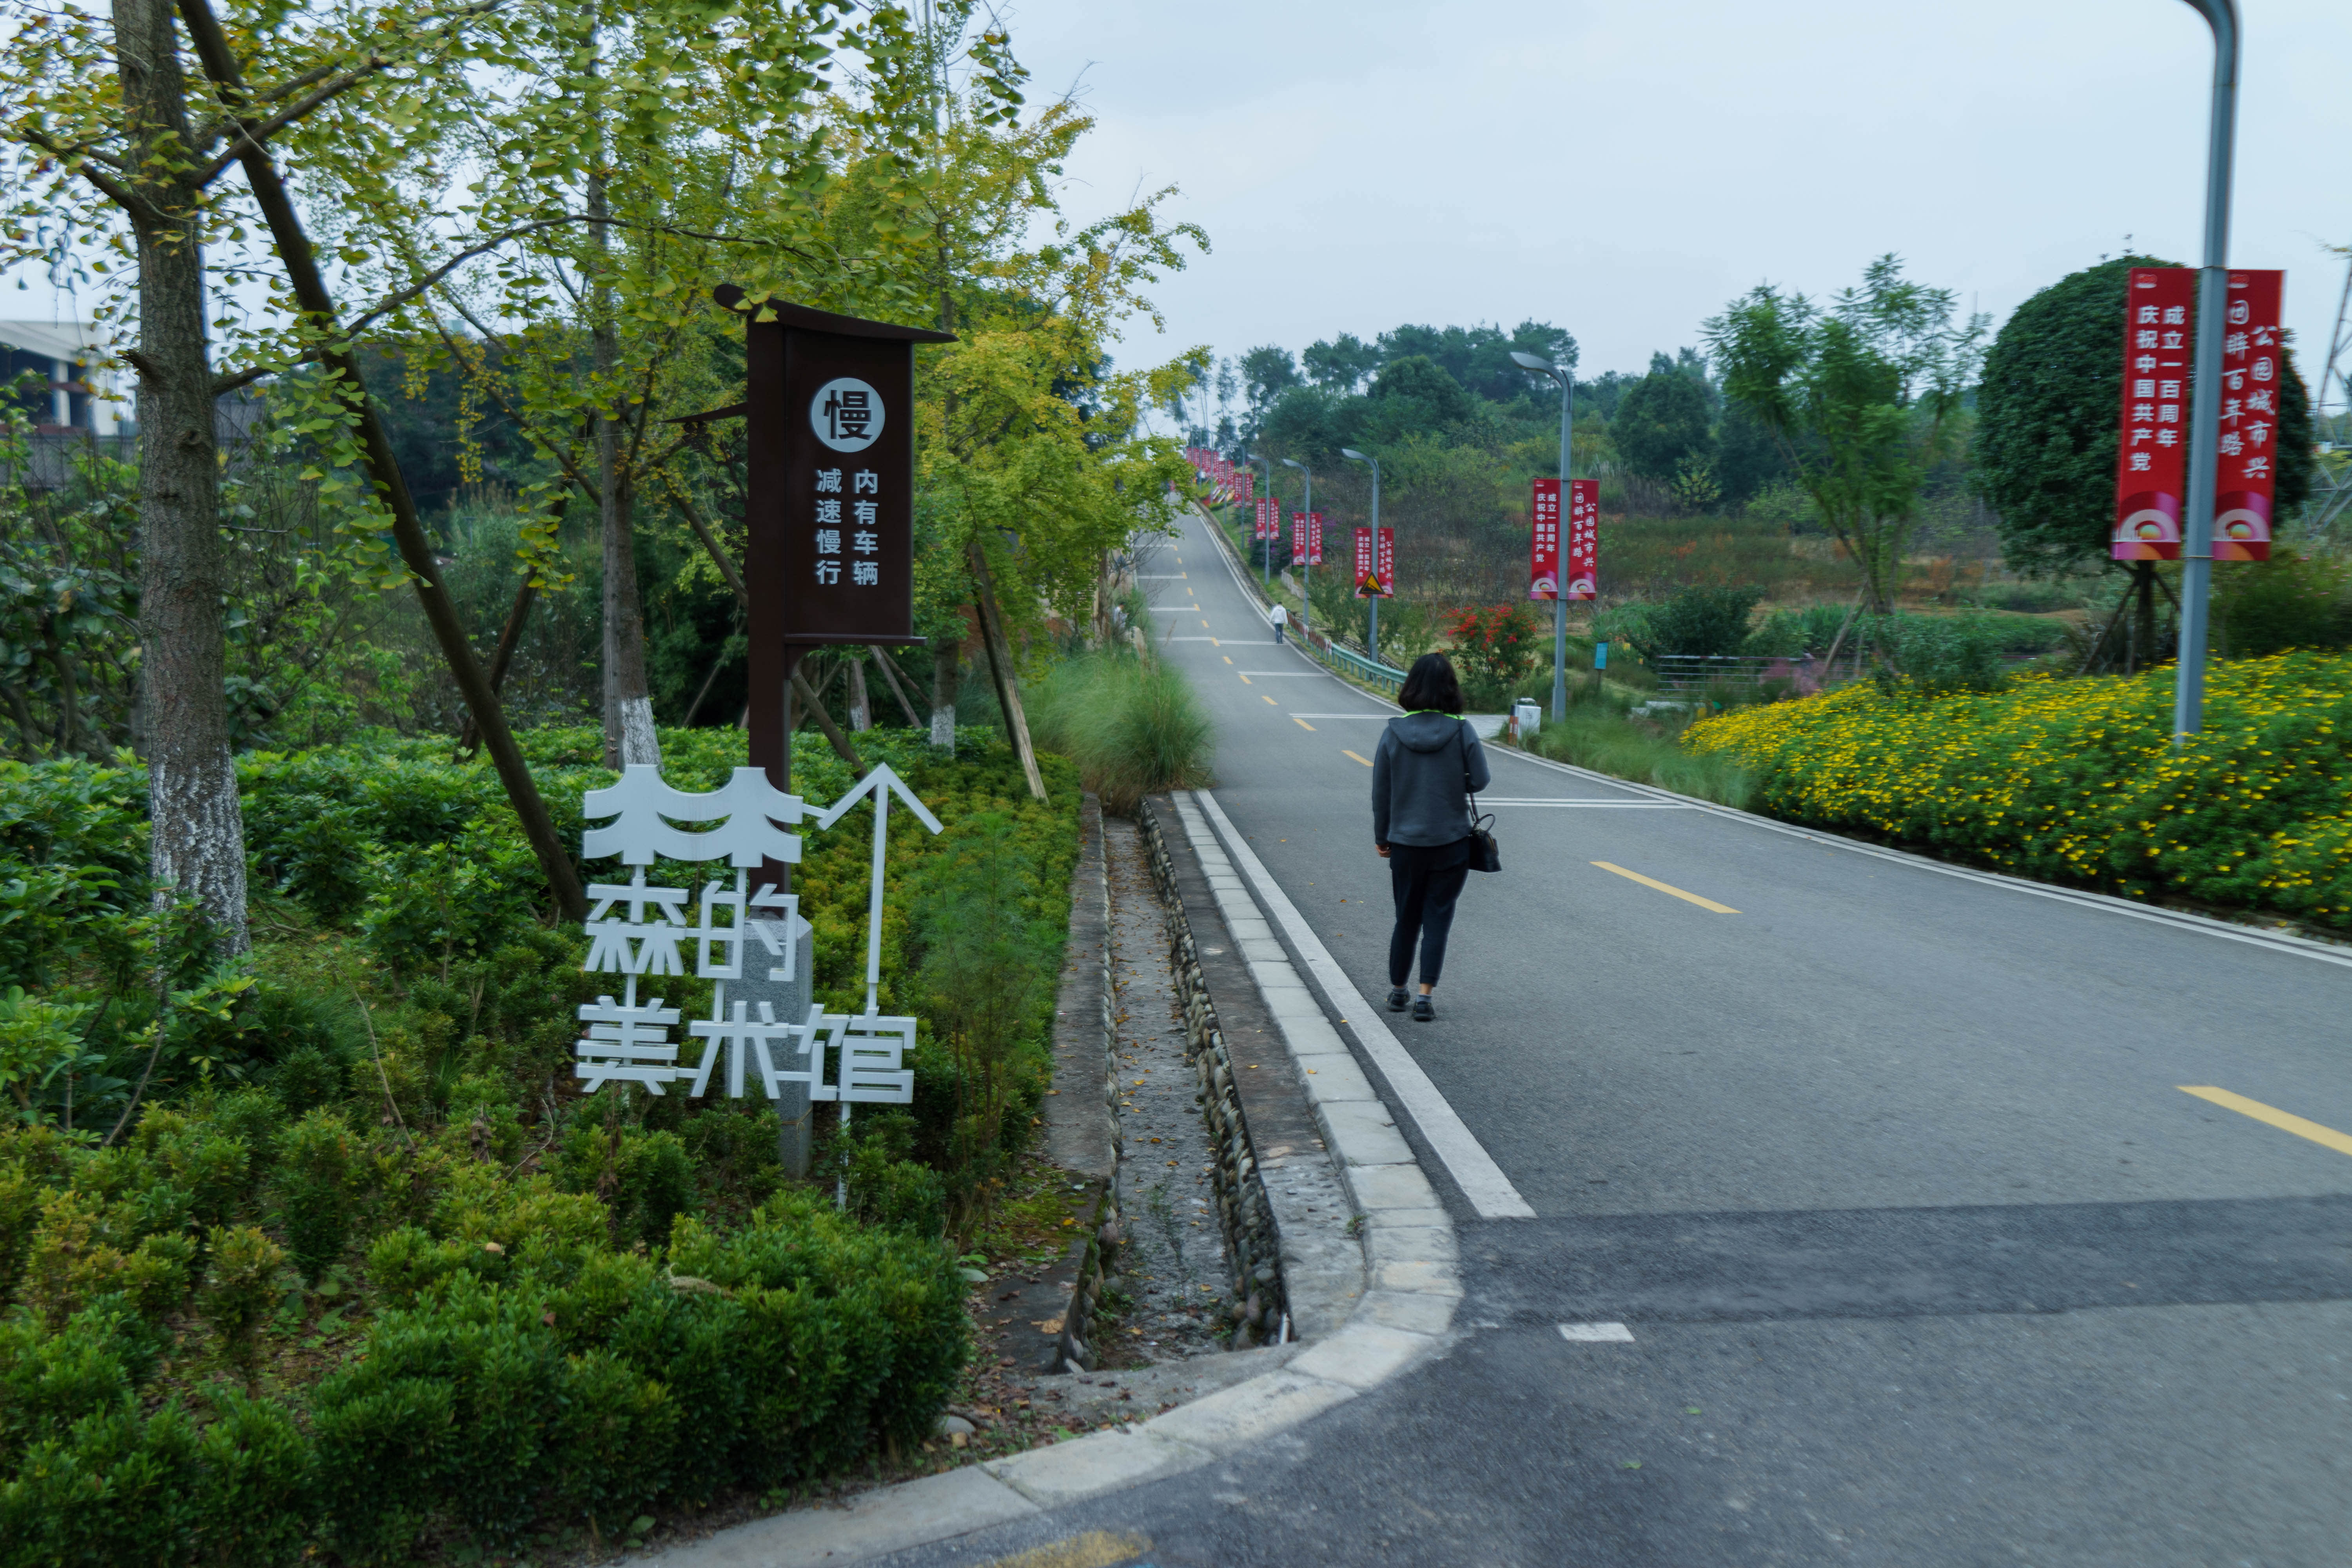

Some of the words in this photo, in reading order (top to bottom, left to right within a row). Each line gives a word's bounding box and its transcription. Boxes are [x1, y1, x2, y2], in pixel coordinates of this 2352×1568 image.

[824, 390, 873, 440] 慢
[2130, 305, 2159, 471] 庆祝中国共产党
[2156, 305, 2185, 448] 成立一百周年
[817, 469, 842, 585] 减速慢行
[854, 469, 878, 585] 内有车辆
[1535, 494, 1546, 562] 庆祝中国共产党
[1546, 494, 1557, 552] 成立一百周年
[584, 877, 799, 982] 森的
[576, 995, 916, 1103] 美术馆
